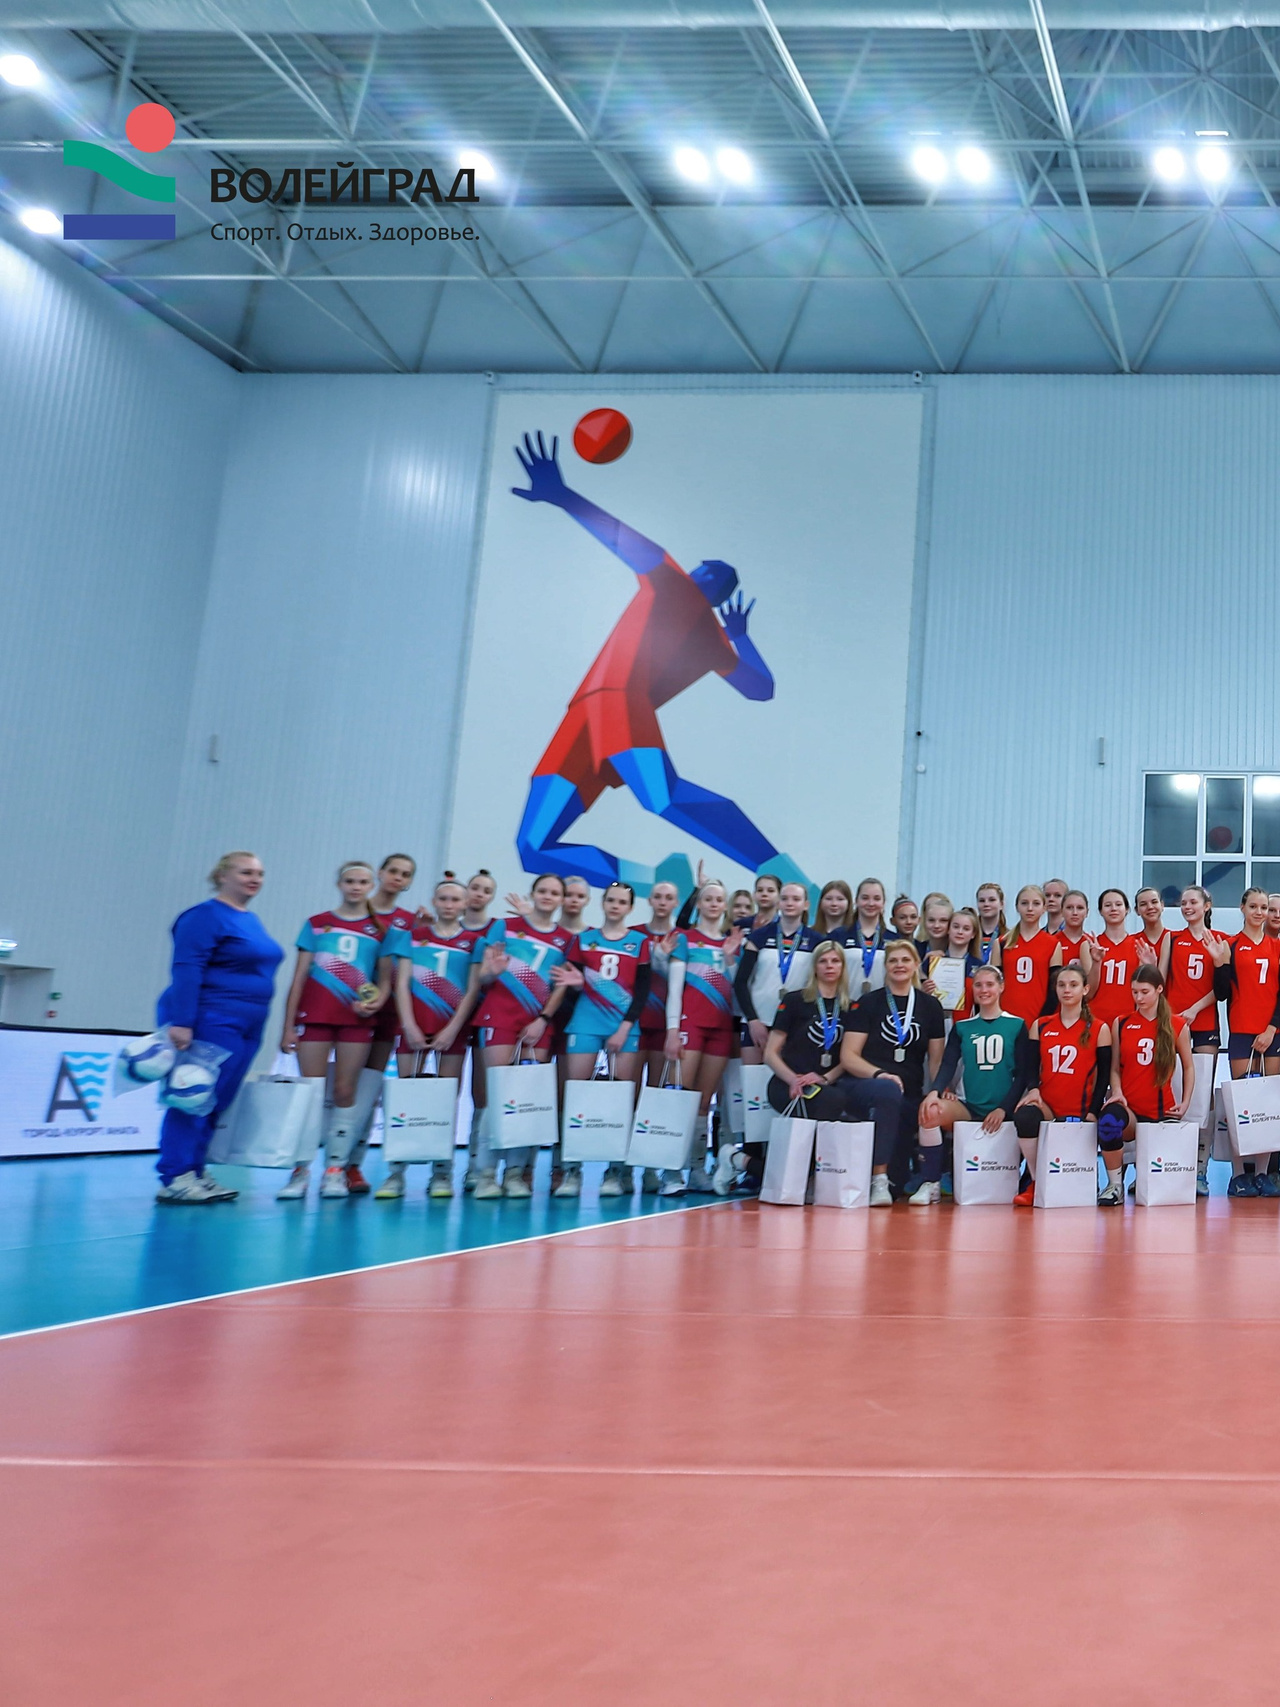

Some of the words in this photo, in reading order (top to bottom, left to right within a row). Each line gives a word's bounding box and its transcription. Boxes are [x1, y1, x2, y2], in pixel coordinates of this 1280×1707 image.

[338, 935, 359, 962] 9
[531, 944, 549, 972] 7
[434, 950, 449, 977] 1
[600, 954, 619, 980] 8
[1016, 956, 1033, 983] 9
[1103, 958, 1127, 985] 11
[1187, 953, 1204, 980] 5
[1255, 958, 1269, 984] 7
[972, 1034, 1004, 1065] 10
[1048, 1045, 1078, 1075] 12
[1137, 1038, 1154, 1066] 3
